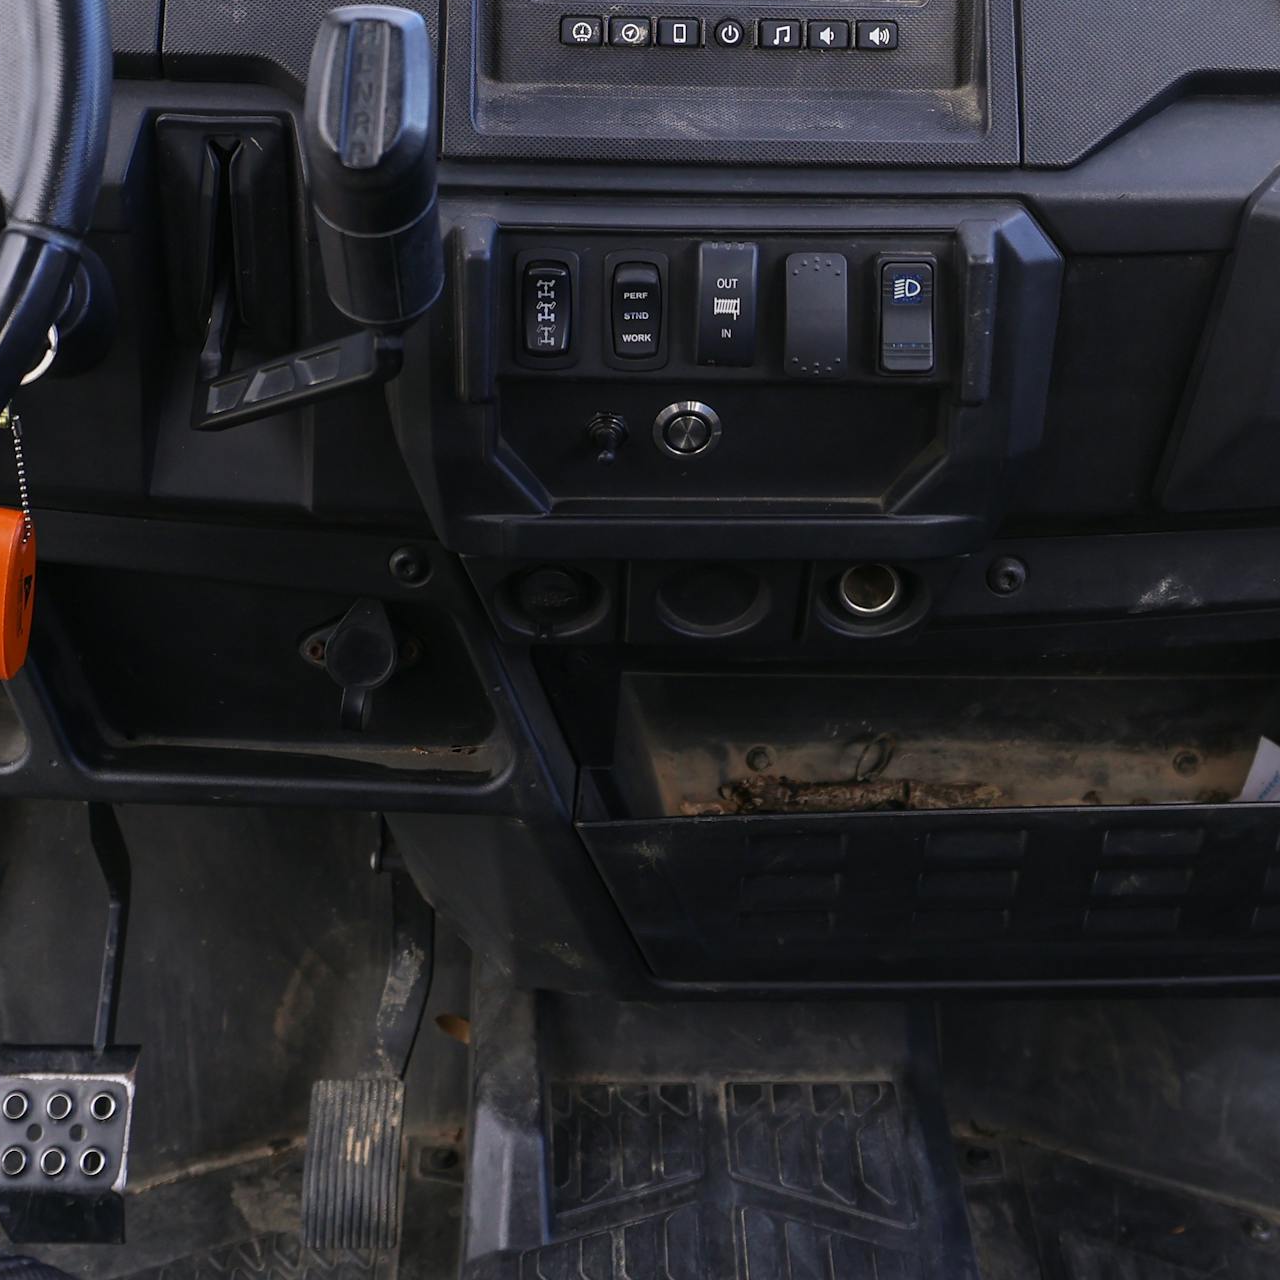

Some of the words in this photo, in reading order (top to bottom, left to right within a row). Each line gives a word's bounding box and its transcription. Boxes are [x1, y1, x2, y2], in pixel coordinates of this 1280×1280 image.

[716, 278, 738, 289] OUT
[623, 291, 649, 300] PERF
[623, 312, 650, 320] STND
[622, 333, 652, 343] WORK
[721, 328, 732, 338] IN
